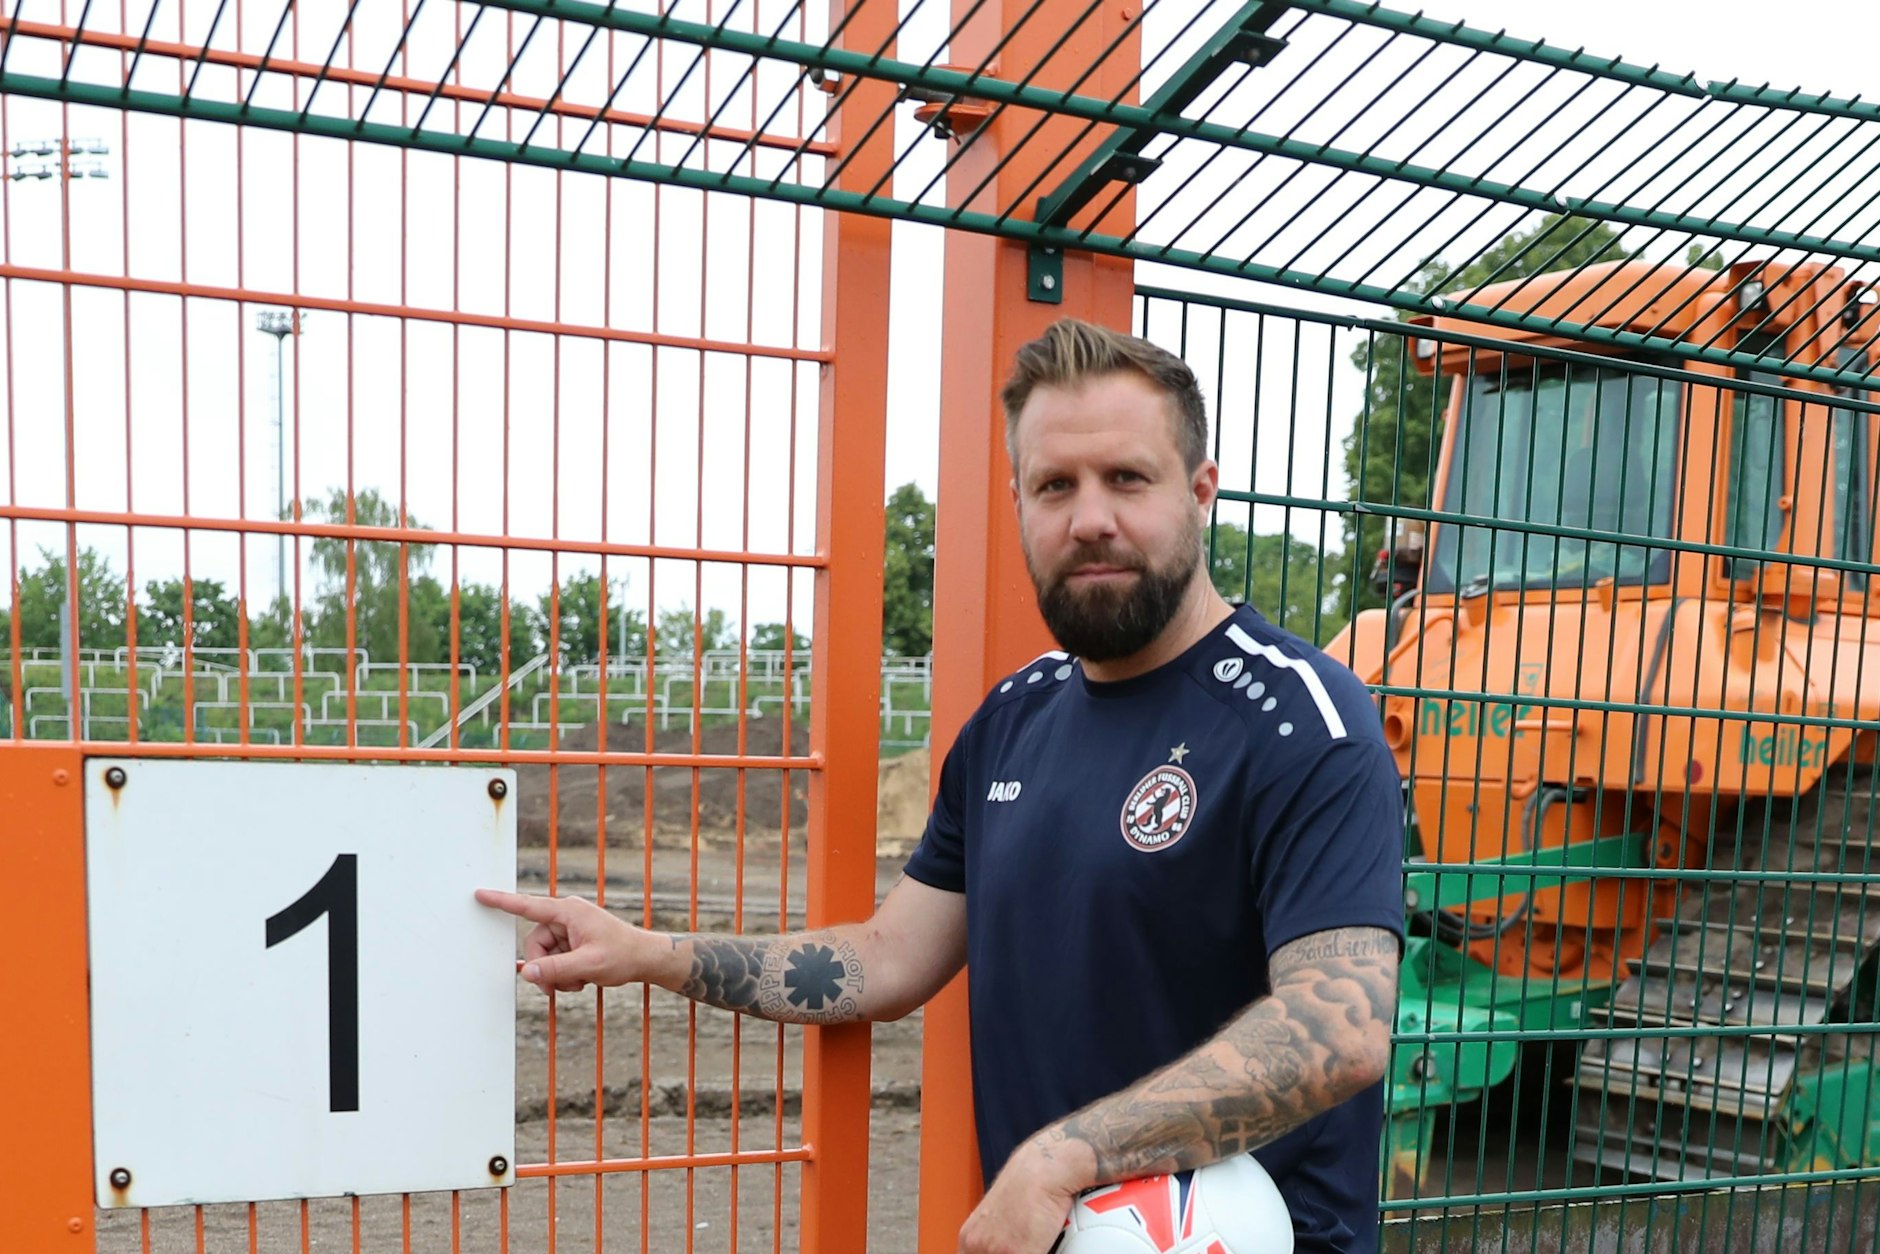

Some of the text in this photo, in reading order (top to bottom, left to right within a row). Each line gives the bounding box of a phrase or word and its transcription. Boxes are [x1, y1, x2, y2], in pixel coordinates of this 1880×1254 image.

[1421, 698, 1532, 738] heier
[986, 781, 1022, 802] JAKO
[1128, 773, 1191, 820] BERLINER FUSSBALL CLUB
[1129, 826, 1170, 845] DYNAMO
[265, 853, 360, 1112] 1
[838, 941, 865, 994] HOT
